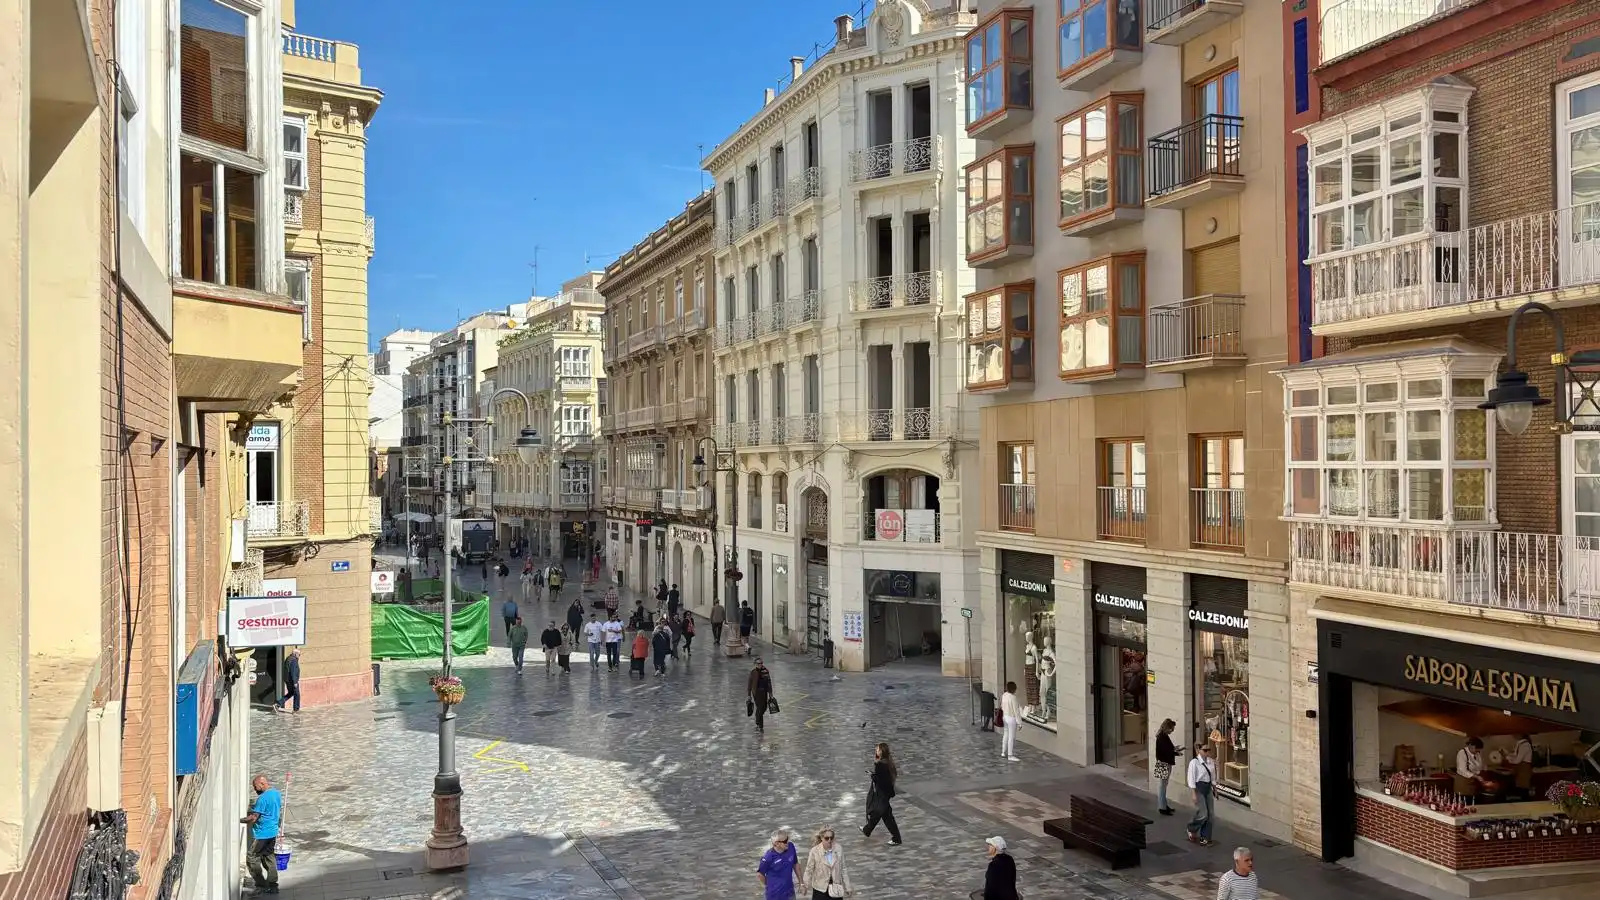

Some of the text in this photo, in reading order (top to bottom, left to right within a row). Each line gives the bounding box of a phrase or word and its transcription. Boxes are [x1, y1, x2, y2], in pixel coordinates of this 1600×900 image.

[1008, 578, 1048, 593] CALZEDONIA
[1095, 593, 1145, 611] CALZEDONIA
[238, 617, 299, 630] gestmuro
[1188, 609, 1249, 630] CALZEDONIA
[1404, 654, 1577, 712] SABOR A ESPAÑA
